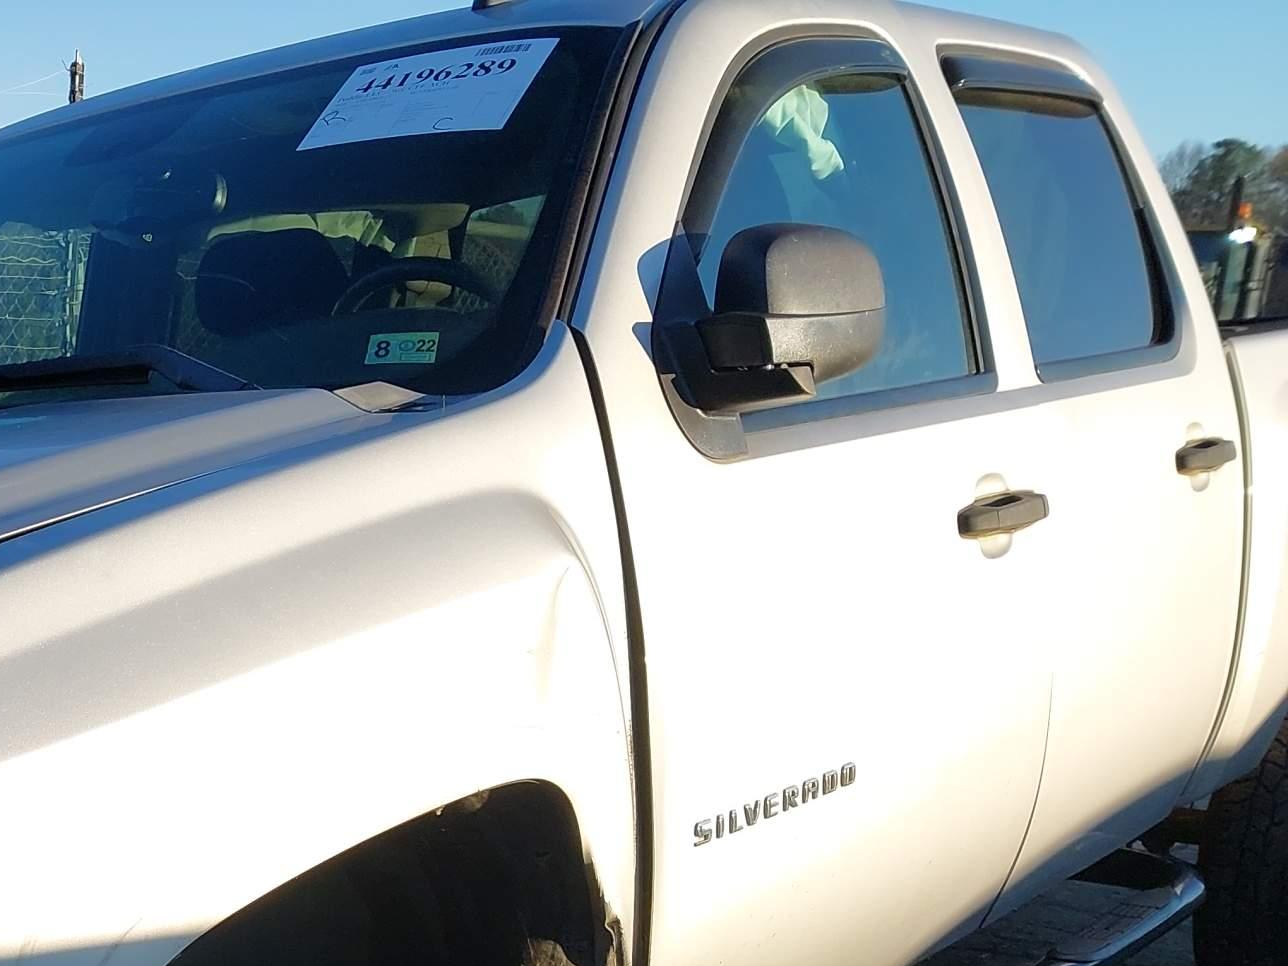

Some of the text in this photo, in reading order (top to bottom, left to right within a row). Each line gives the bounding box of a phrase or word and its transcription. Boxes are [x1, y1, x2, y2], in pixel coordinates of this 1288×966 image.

[356, 58, 517, 94] 44196289
[374, 340, 392, 358] 8
[415, 339, 437, 353] 22
[693, 761, 857, 847] SILVERADO
